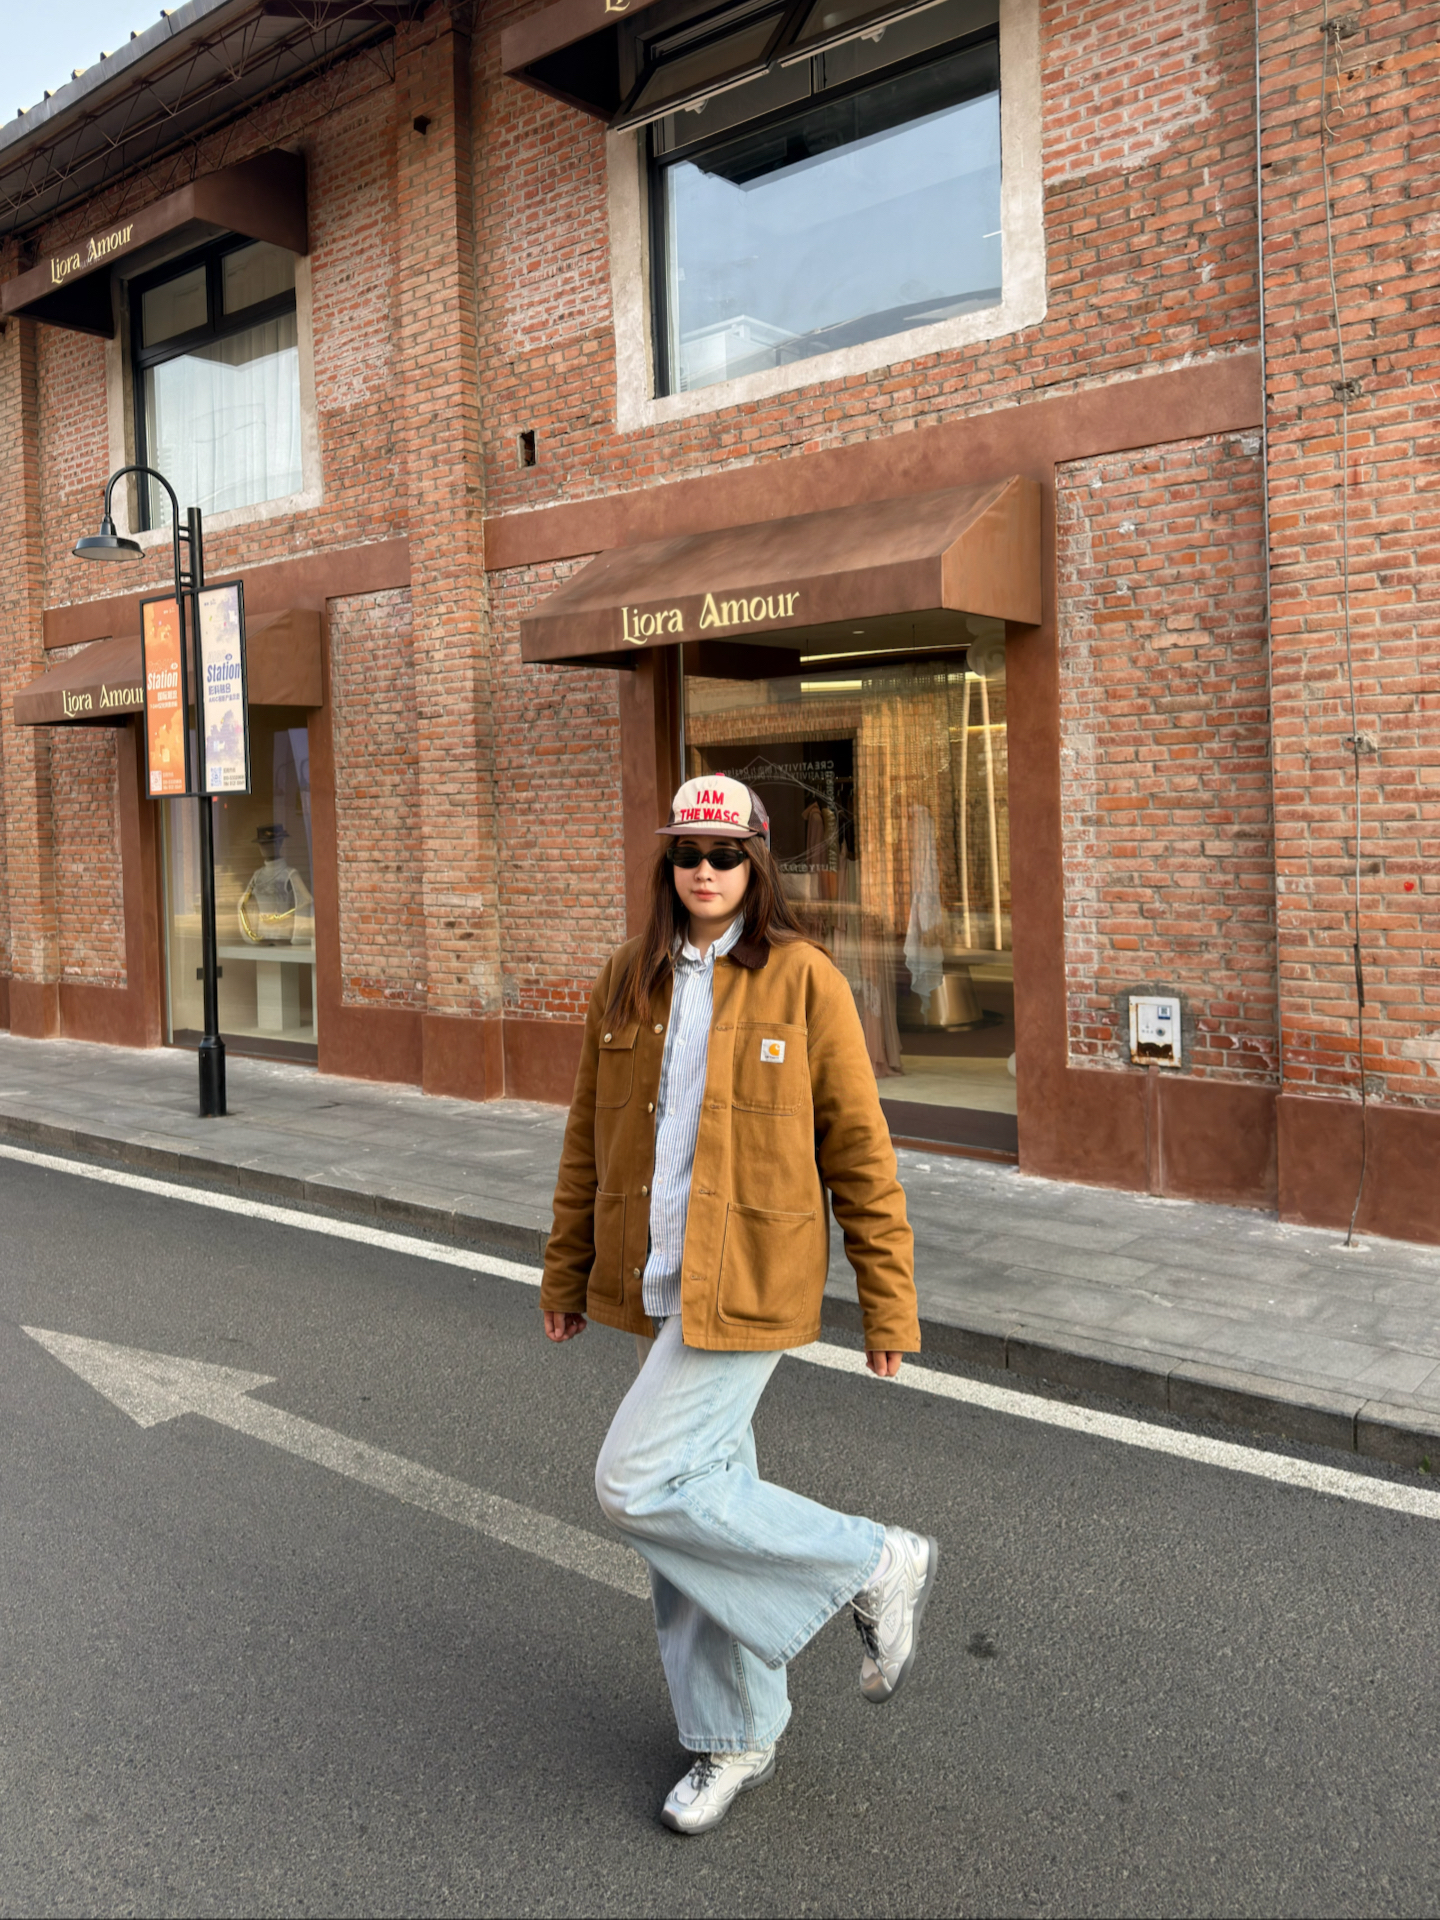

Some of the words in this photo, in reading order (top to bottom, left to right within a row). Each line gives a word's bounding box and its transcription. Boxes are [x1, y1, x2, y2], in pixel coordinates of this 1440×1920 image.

[51, 252, 81, 284] Liora
[87, 224, 134, 263] Amour
[621, 607, 684, 645] Liora
[699, 591, 800, 629] Amour
[147, 670, 178, 691] Station
[207, 661, 240, 683] Station
[62, 690, 93, 717] Liora
[696, 791, 701, 805] I
[701, 790, 724, 805] AM
[680, 808, 701, 822] THE
[703, 808, 740, 824] WASC
